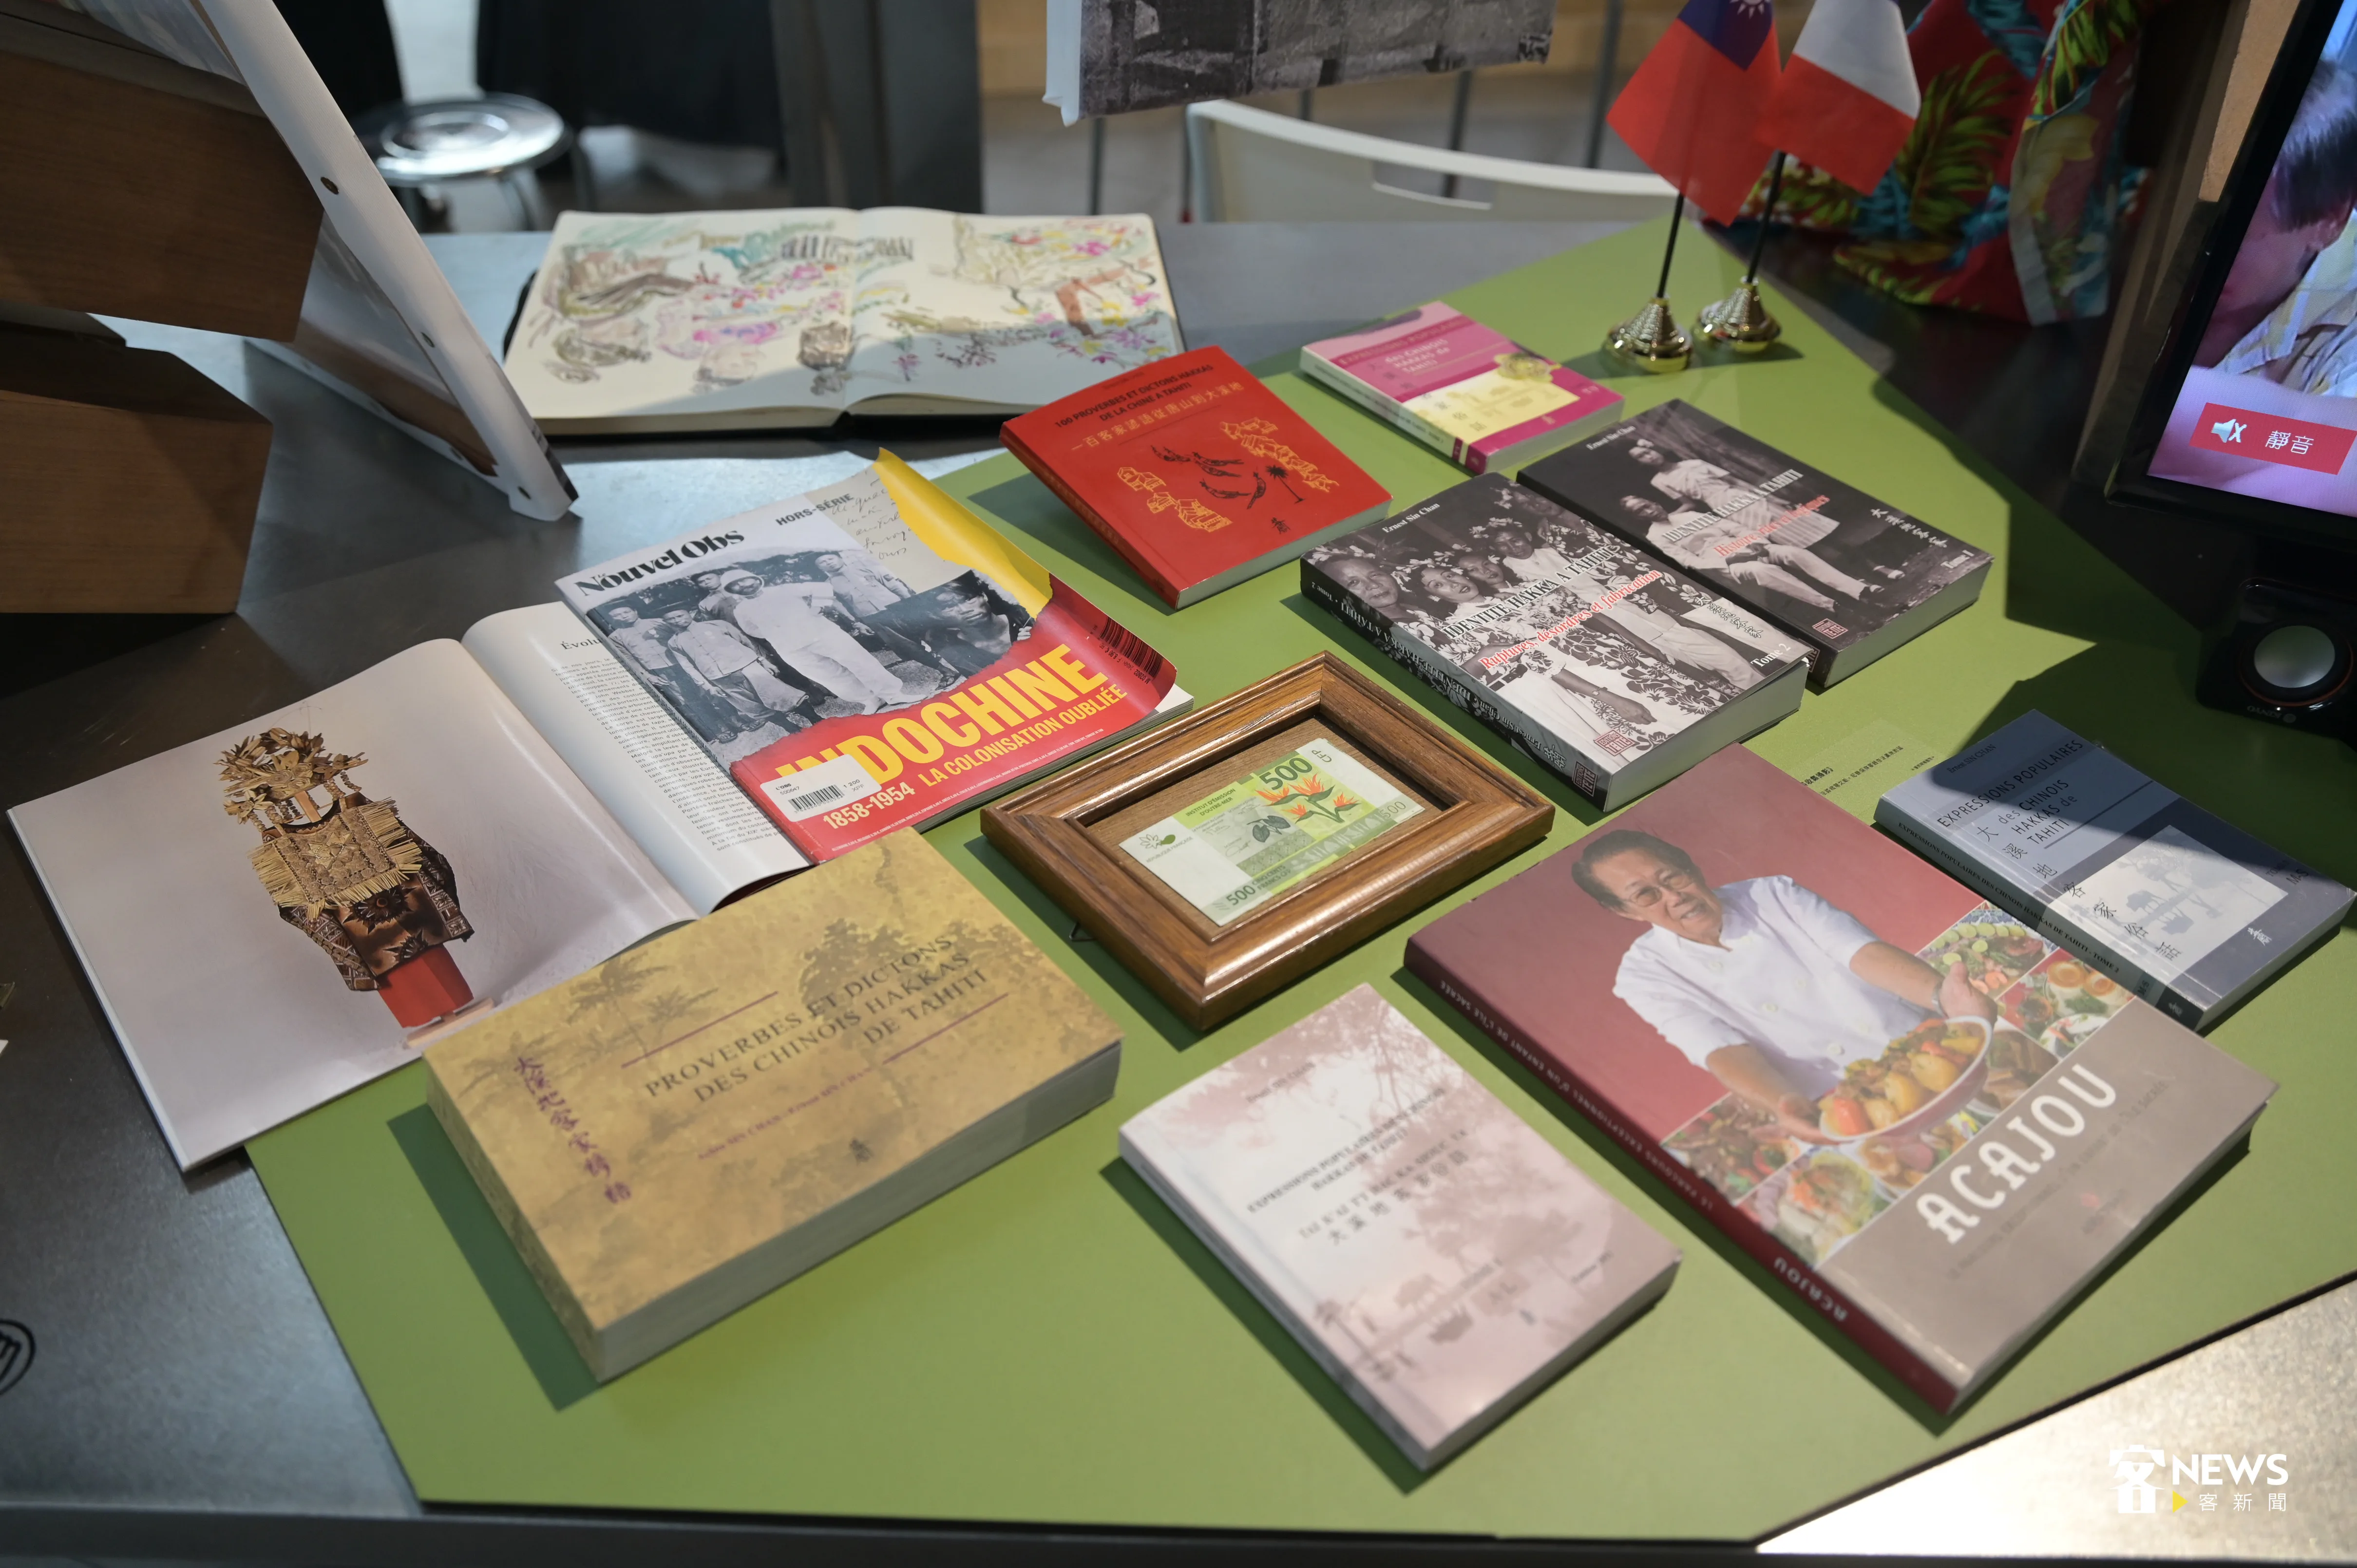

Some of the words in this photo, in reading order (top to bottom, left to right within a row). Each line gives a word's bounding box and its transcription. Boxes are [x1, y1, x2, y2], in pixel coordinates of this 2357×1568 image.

[1072, 395, 1127, 420] PROVERBES
[1126, 390, 1139, 398] ET
[1138, 376, 1178, 394] DICTONS
[1100, 412, 1113, 421] DE
[1113, 407, 1127, 416] LA
[1127, 396, 1156, 411] CHINE
[2265, 430, 2314, 455] 靜音
[775, 493, 855, 527] HORS-SÉRIE
[1382, 519, 1407, 534] Ernest
[1406, 512, 1420, 523] Sin
[1419, 503, 1441, 516] Chan
[574, 542, 684, 596] Nouvel
[682, 529, 744, 559] Obs
[1317, 585, 1333, 602] Tome
[1441, 603, 1511, 639] IDENTITE
[1507, 578, 1559, 610] HAKKA
[1555, 571, 1570, 584] A
[1565, 546, 1617, 577] TAHITI
[1478, 637, 1539, 670] Ruptures,
[1536, 607, 1592, 647] désordres
[1590, 601, 1604, 613] et
[1604, 569, 1662, 609] fabrication
[1750, 649, 1784, 667] Tome
[1779, 643, 1791, 651] 2
[597, 684, 630, 693] ornements
[776, 644, 1108, 786] DOCHINE
[1514, 725, 1542, 750] Ernest
[630, 750, 654, 758] Malgré
[639, 756, 678, 768] illustrations
[681, 760, 707, 770] illustrés
[822, 782, 916, 830] 1858-1954
[917, 767, 949, 787] LA
[946, 717, 1059, 782] COLONISATION
[1056, 682, 1128, 726] OUBLIÉE
[1311, 750, 1332, 763] CFP
[1947, 762, 1965, 774] Ernest
[1964, 755, 1976, 765] SIN
[1975, 744, 1996, 757] CHAN
[775, 782, 792, 791] L'OBS
[851, 783, 865, 792] XPF
[1258, 757, 1312, 791] 500
[1937, 780, 2015, 828] EXPRESSIONS
[2014, 740, 2083, 783] POPULAIRES
[707, 796, 733, 806] fraîches
[779, 786, 800, 795] 500647
[1185, 802, 1209, 817] INSTITUT
[1208, 788, 1236, 806] D'ÉMISSION
[1998, 809, 2020, 824] des
[2019, 780, 2069, 810] CHINOIS
[1199, 797, 1233, 816] D'OUTRE-MER
[1380, 801, 1407, 819] 500
[2011, 805, 2060, 834] HAKKAS
[2060, 795, 2077, 807] de
[2027, 819, 2070, 844] TAHITI
[1226, 885, 1256, 906] 500
[1899, 822, 1947, 855] EXPRESSIONS
[1940, 854, 1981, 881] POPULAIRES
[1981, 877, 1995, 889] DES
[1995, 887, 2024, 909] CHINOIS
[2023, 906, 2053, 928] HAKKAS
[2053, 925, 2064, 937] DE
[2063, 933, 2089, 953] TAHITI
[2092, 952, 2115, 970] TOME
[1977, 826, 2182, 961] 大溪地客家俗語
[645, 1012, 802, 1097] PROVERBES
[806, 994, 838, 1017] ET
[843, 935, 953, 998] DICTONS
[863, 1018, 901, 1044] DE
[902, 968, 988, 1020] TAHITI
[694, 1067, 749, 1103] DES
[753, 1008, 861, 1072] CHINOIS
[864, 952, 970, 1014] HAKKAS
[1916, 1063, 2117, 1245] ACAJOU
[1773, 1257, 1849, 1322] ACAJOU
